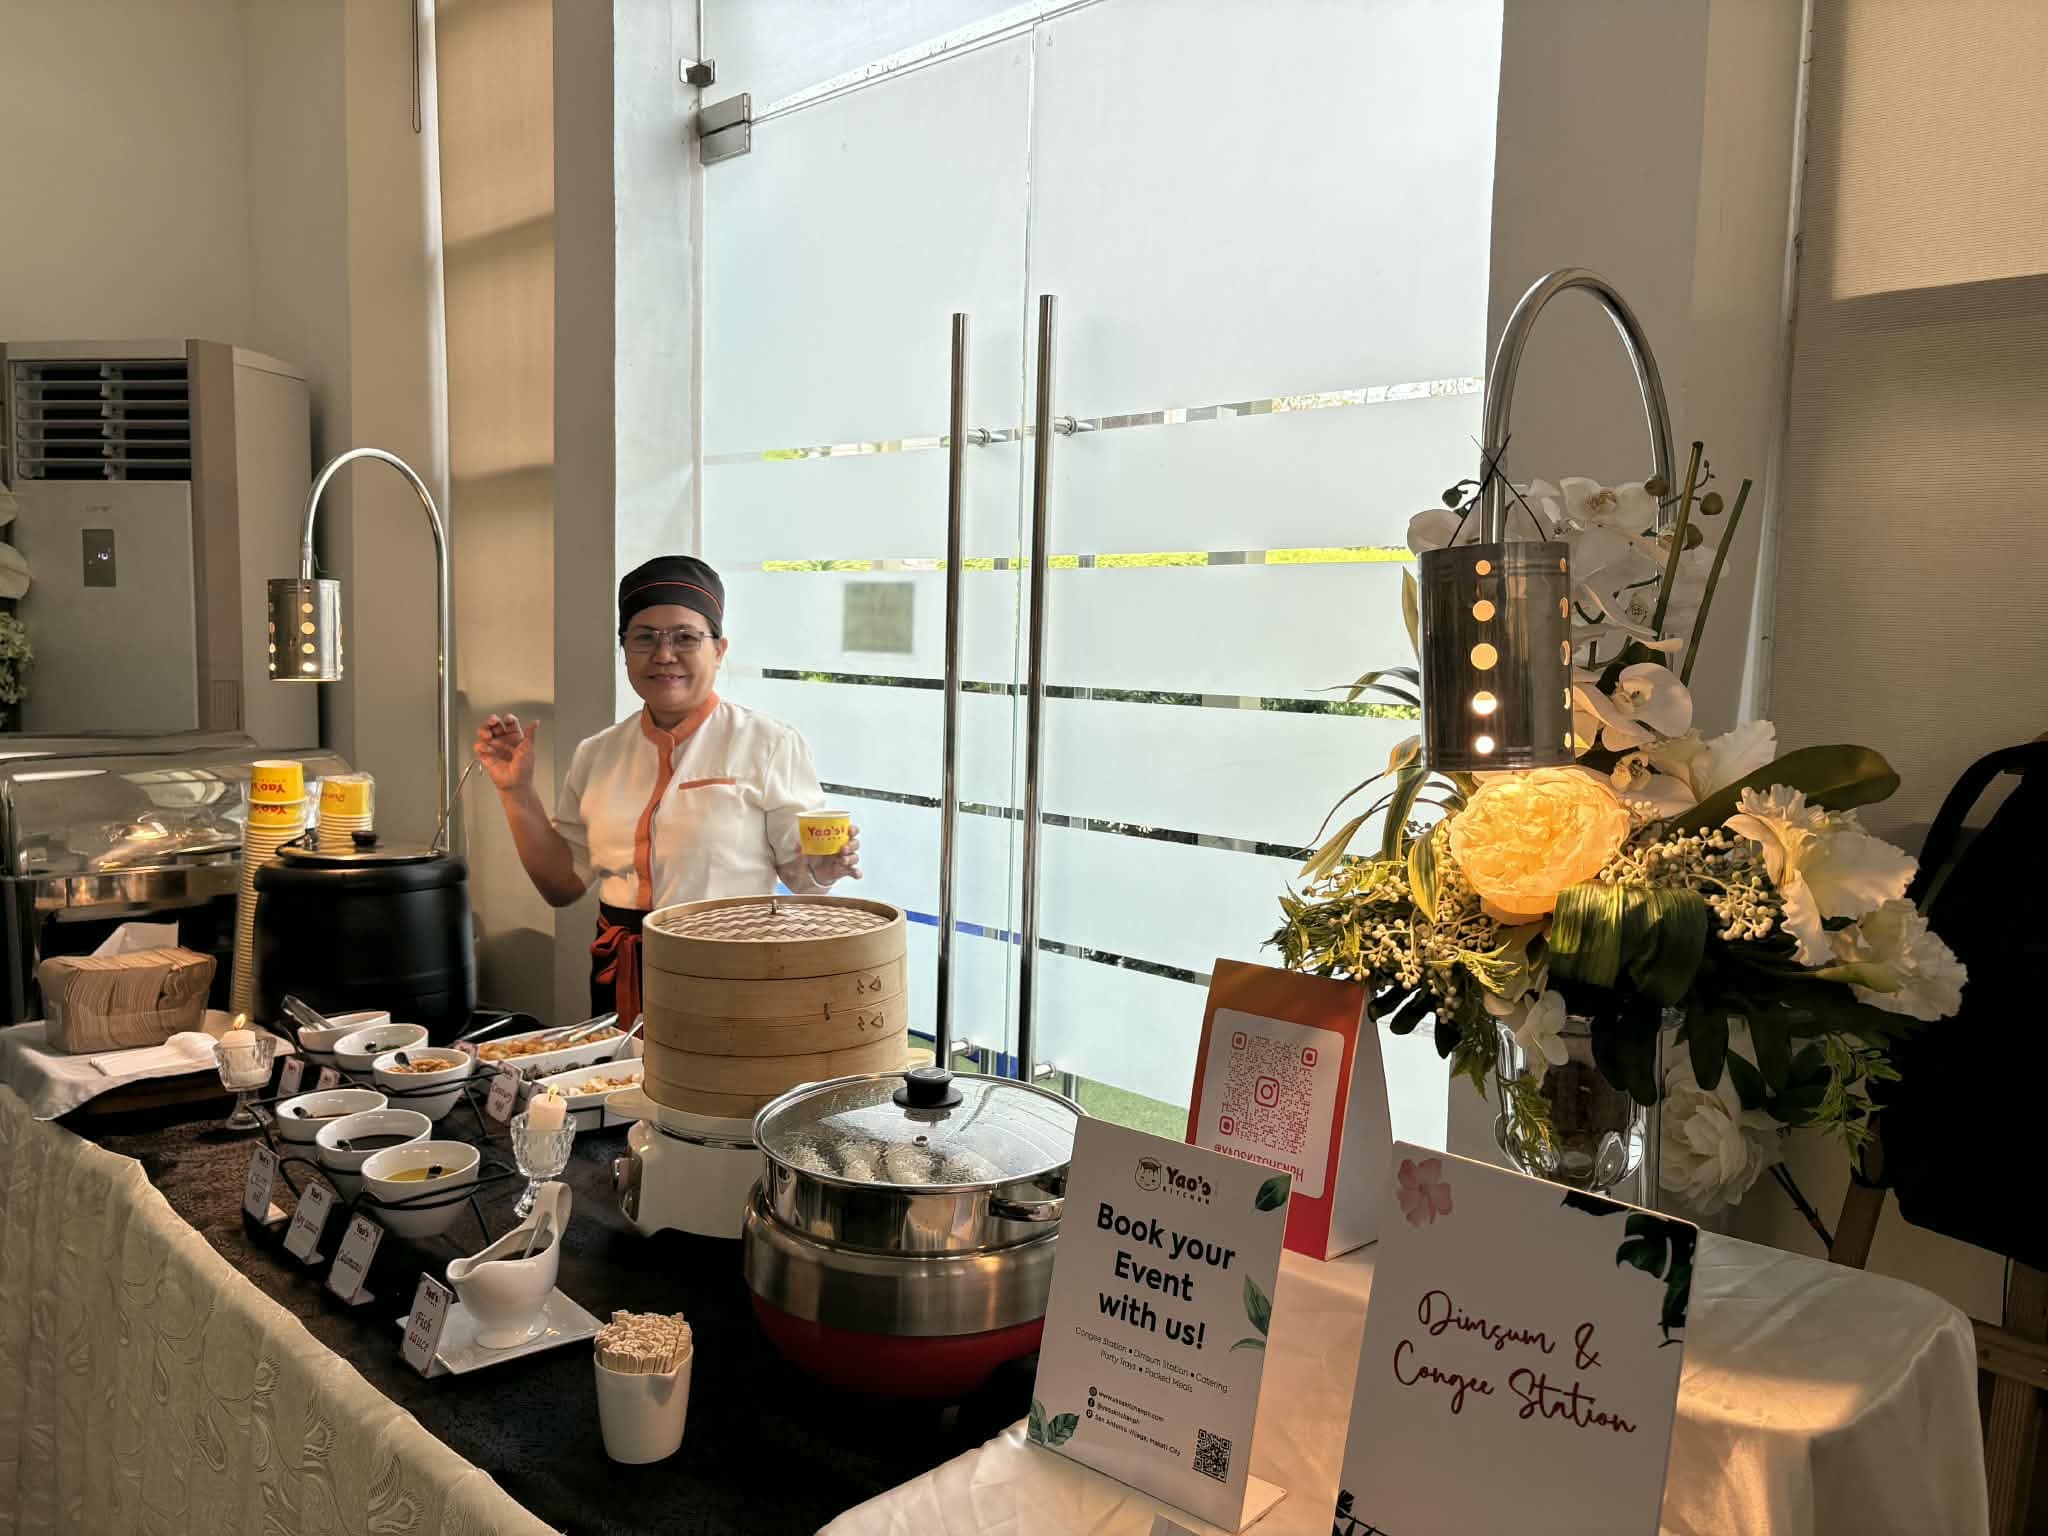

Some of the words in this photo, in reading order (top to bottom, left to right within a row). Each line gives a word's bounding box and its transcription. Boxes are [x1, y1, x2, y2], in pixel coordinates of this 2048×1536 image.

[1166, 1166, 1211, 1196] Yao's
[1097, 1202, 1166, 1249] Book
[1168, 1231, 1236, 1270] your
[1114, 1249, 1194, 1302] Event
[1098, 1292, 1157, 1333] with
[1165, 1317, 1206, 1350] us!
[1418, 1290, 1556, 1354] Dimsum
[1574, 1322, 1603, 1370] &
[1075, 1326, 1102, 1343] Congee
[1102, 1337, 1127, 1354] Station
[1133, 1349, 1161, 1367] Dimsum
[1163, 1360, 1189, 1377] Station
[1195, 1372, 1228, 1394] Catering
[1100, 1350, 1119, 1365] Party
[1119, 1358, 1137, 1371] Trays
[1144, 1367, 1171, 1385] Packed
[1172, 1377, 1193, 1393] Meals
[1394, 1339, 1495, 1415] Congee
[1508, 1367, 1637, 1433] Station
[1169, 1445, 1181, 1457] City
